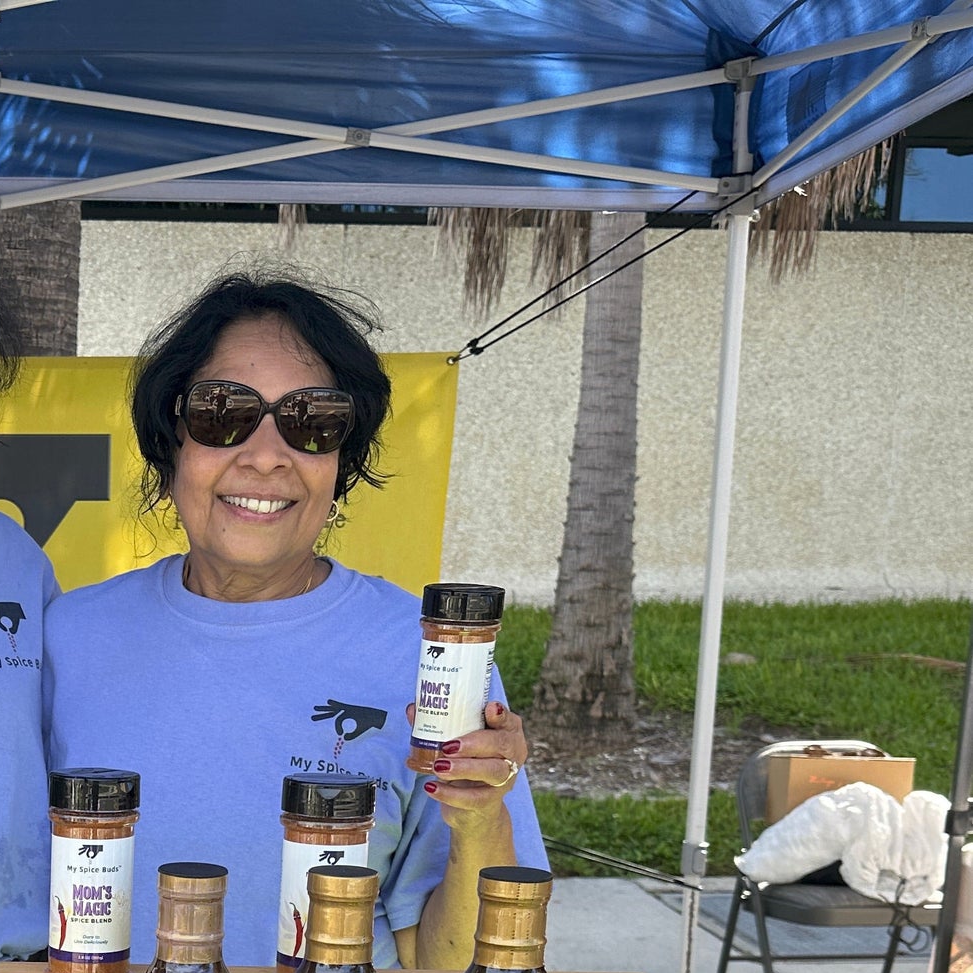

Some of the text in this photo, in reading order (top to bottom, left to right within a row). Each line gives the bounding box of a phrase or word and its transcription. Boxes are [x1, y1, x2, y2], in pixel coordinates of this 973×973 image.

[5, 656, 34, 668] Spice
[420, 679, 451, 697] MOM'S
[419, 695, 449, 710] MAGIC
[290, 756, 312, 772] My
[67, 865, 77, 874] My
[79, 866, 100, 874] Spice
[72, 884, 113, 901] MOM'S
[72, 900, 112, 917] MAGIC
